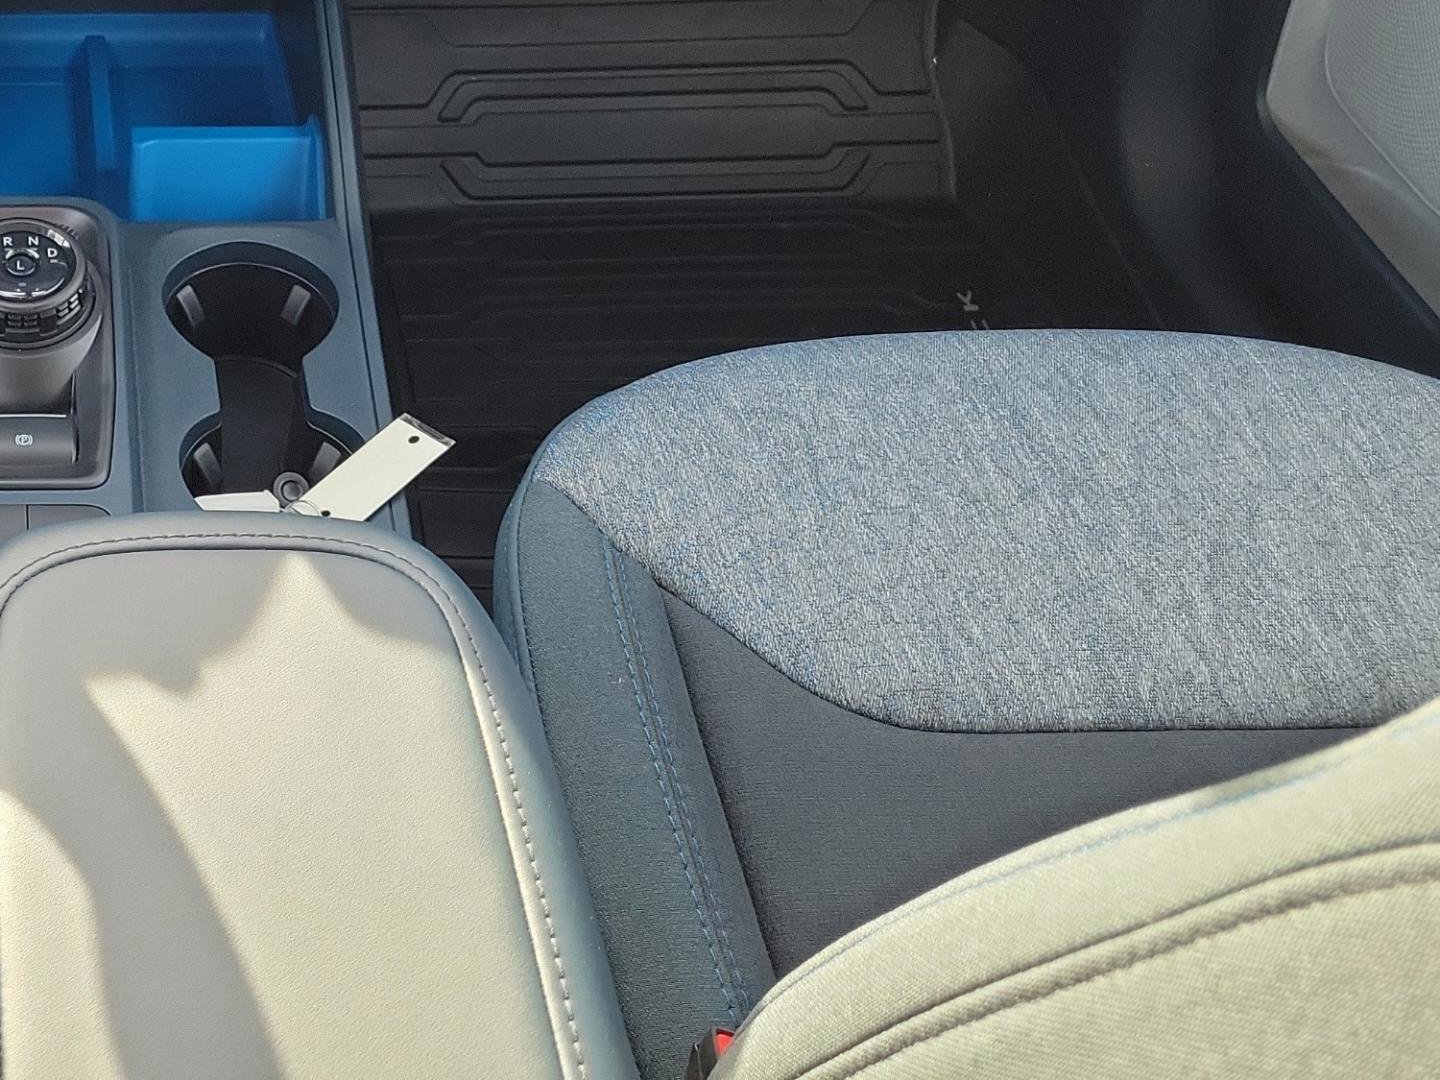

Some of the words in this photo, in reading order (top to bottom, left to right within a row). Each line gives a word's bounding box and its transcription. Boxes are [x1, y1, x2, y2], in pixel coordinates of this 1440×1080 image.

[2, 236, 14, 247] R
[27, 236, 40, 247] N
[46, 247, 59, 258] D
[16, 260, 26, 271] L
